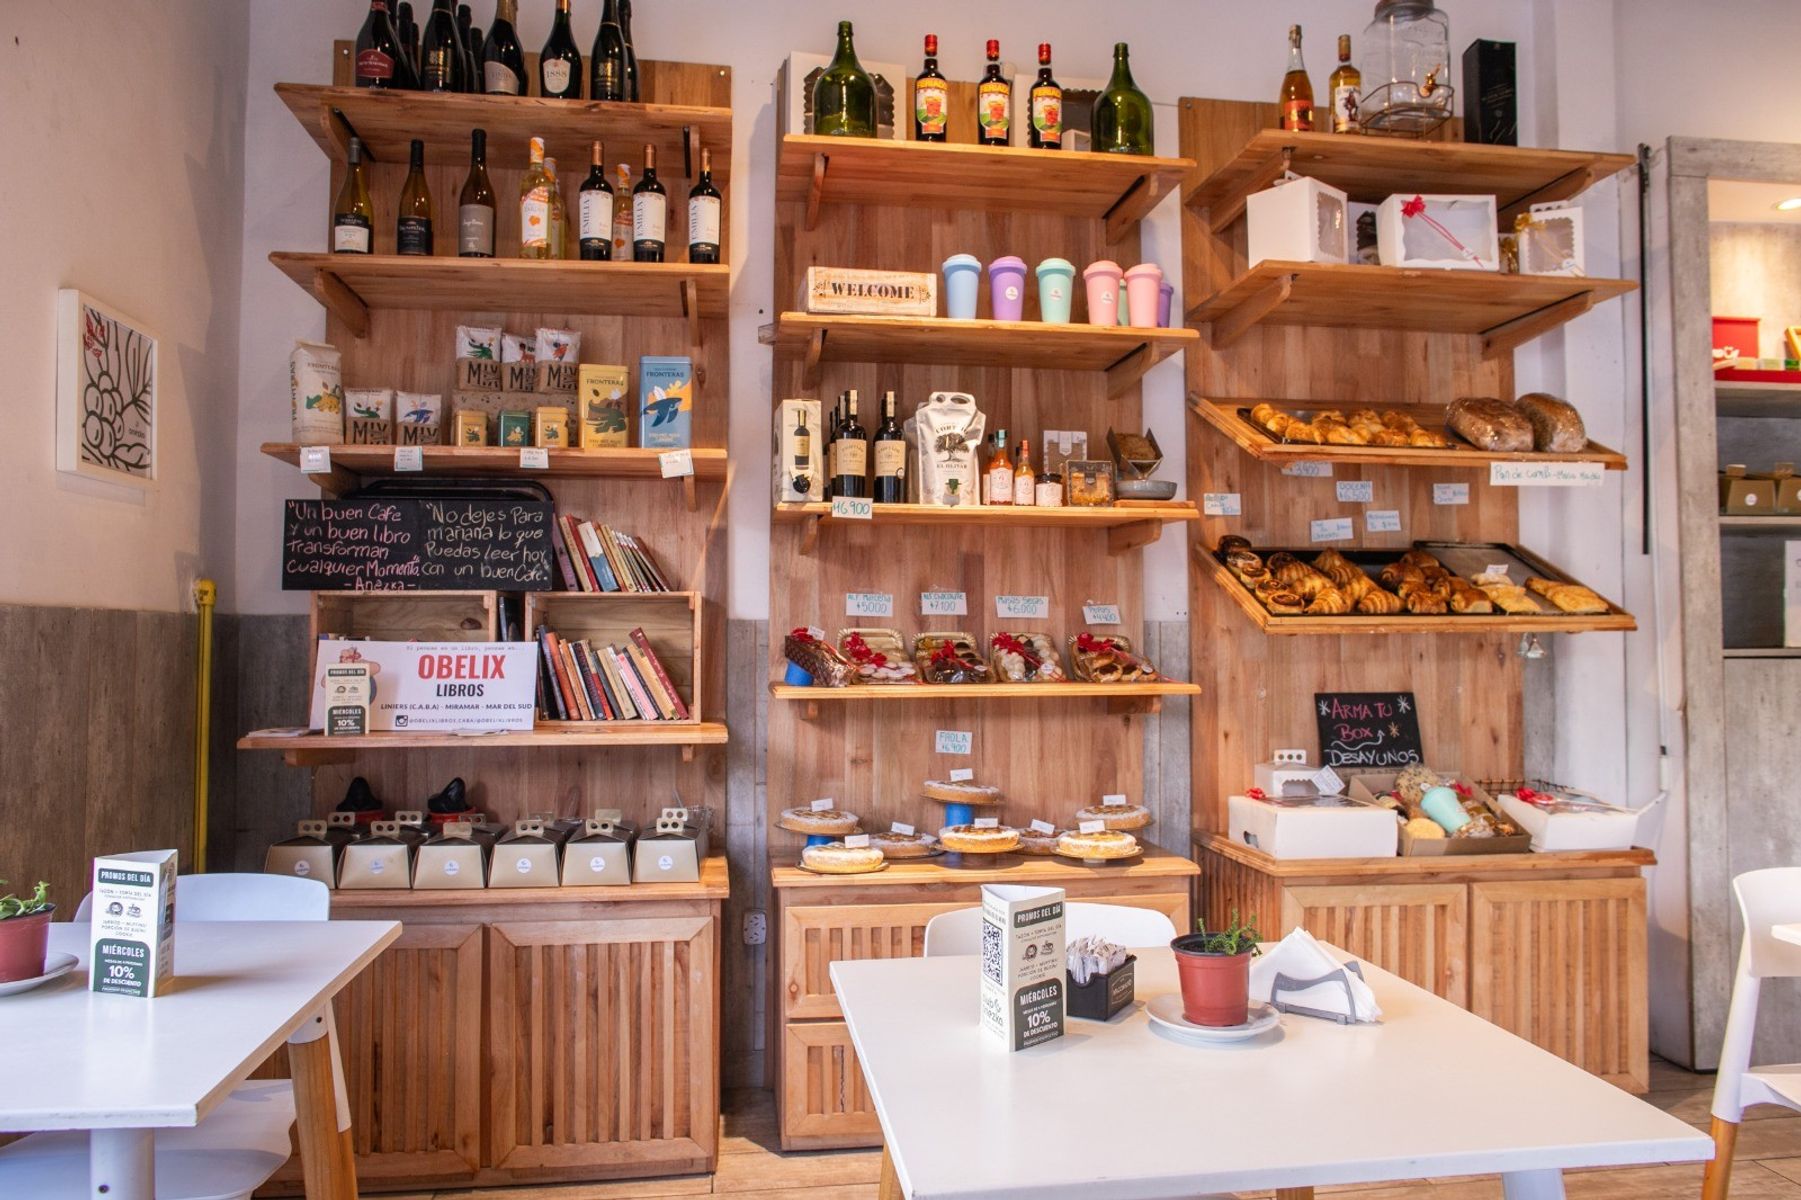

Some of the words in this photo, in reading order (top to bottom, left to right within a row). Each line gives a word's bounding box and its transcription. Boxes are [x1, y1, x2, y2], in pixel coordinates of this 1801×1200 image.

[831, 282, 916, 300] WELCOME
[587, 378, 625, 386] FRONTERAS
[646, 371, 685, 379] FRONTERAS
[321, 501, 363, 521] buen
[368, 503, 402, 522] Cafe
[460, 503, 506, 530] dejes
[510, 506, 544, 526] Para
[304, 525, 323, 536] un
[328, 520, 368, 540] buen
[373, 524, 411, 544] libro
[427, 525, 494, 542] mañana
[498, 524, 512, 541] lo
[514, 528, 544, 549] que
[425, 540, 481, 560] Puedas
[454, 564, 474, 576] un
[480, 561, 514, 579] buen
[418, 654, 506, 680] OBELIX
[436, 684, 484, 697] LIBROS
[1331, 698, 1373, 720] ARMA
[1374, 702, 1393, 718] TU
[939, 732, 968, 742] FROLA
[101, 871, 126, 881] PROMOS
[127, 873, 138, 882] DEL
[140, 874, 151, 883] DÍA
[1017, 910, 1040, 924] PROMOS
[102, 944, 144, 958] MIÉRCOLES
[109, 965, 135, 979] 10%
[1020, 985, 1057, 1006] MIÉRCOLES
[1028, 1010, 1051, 1028] 10%
[1030, 1022, 1058, 1035] DESCUENTO
